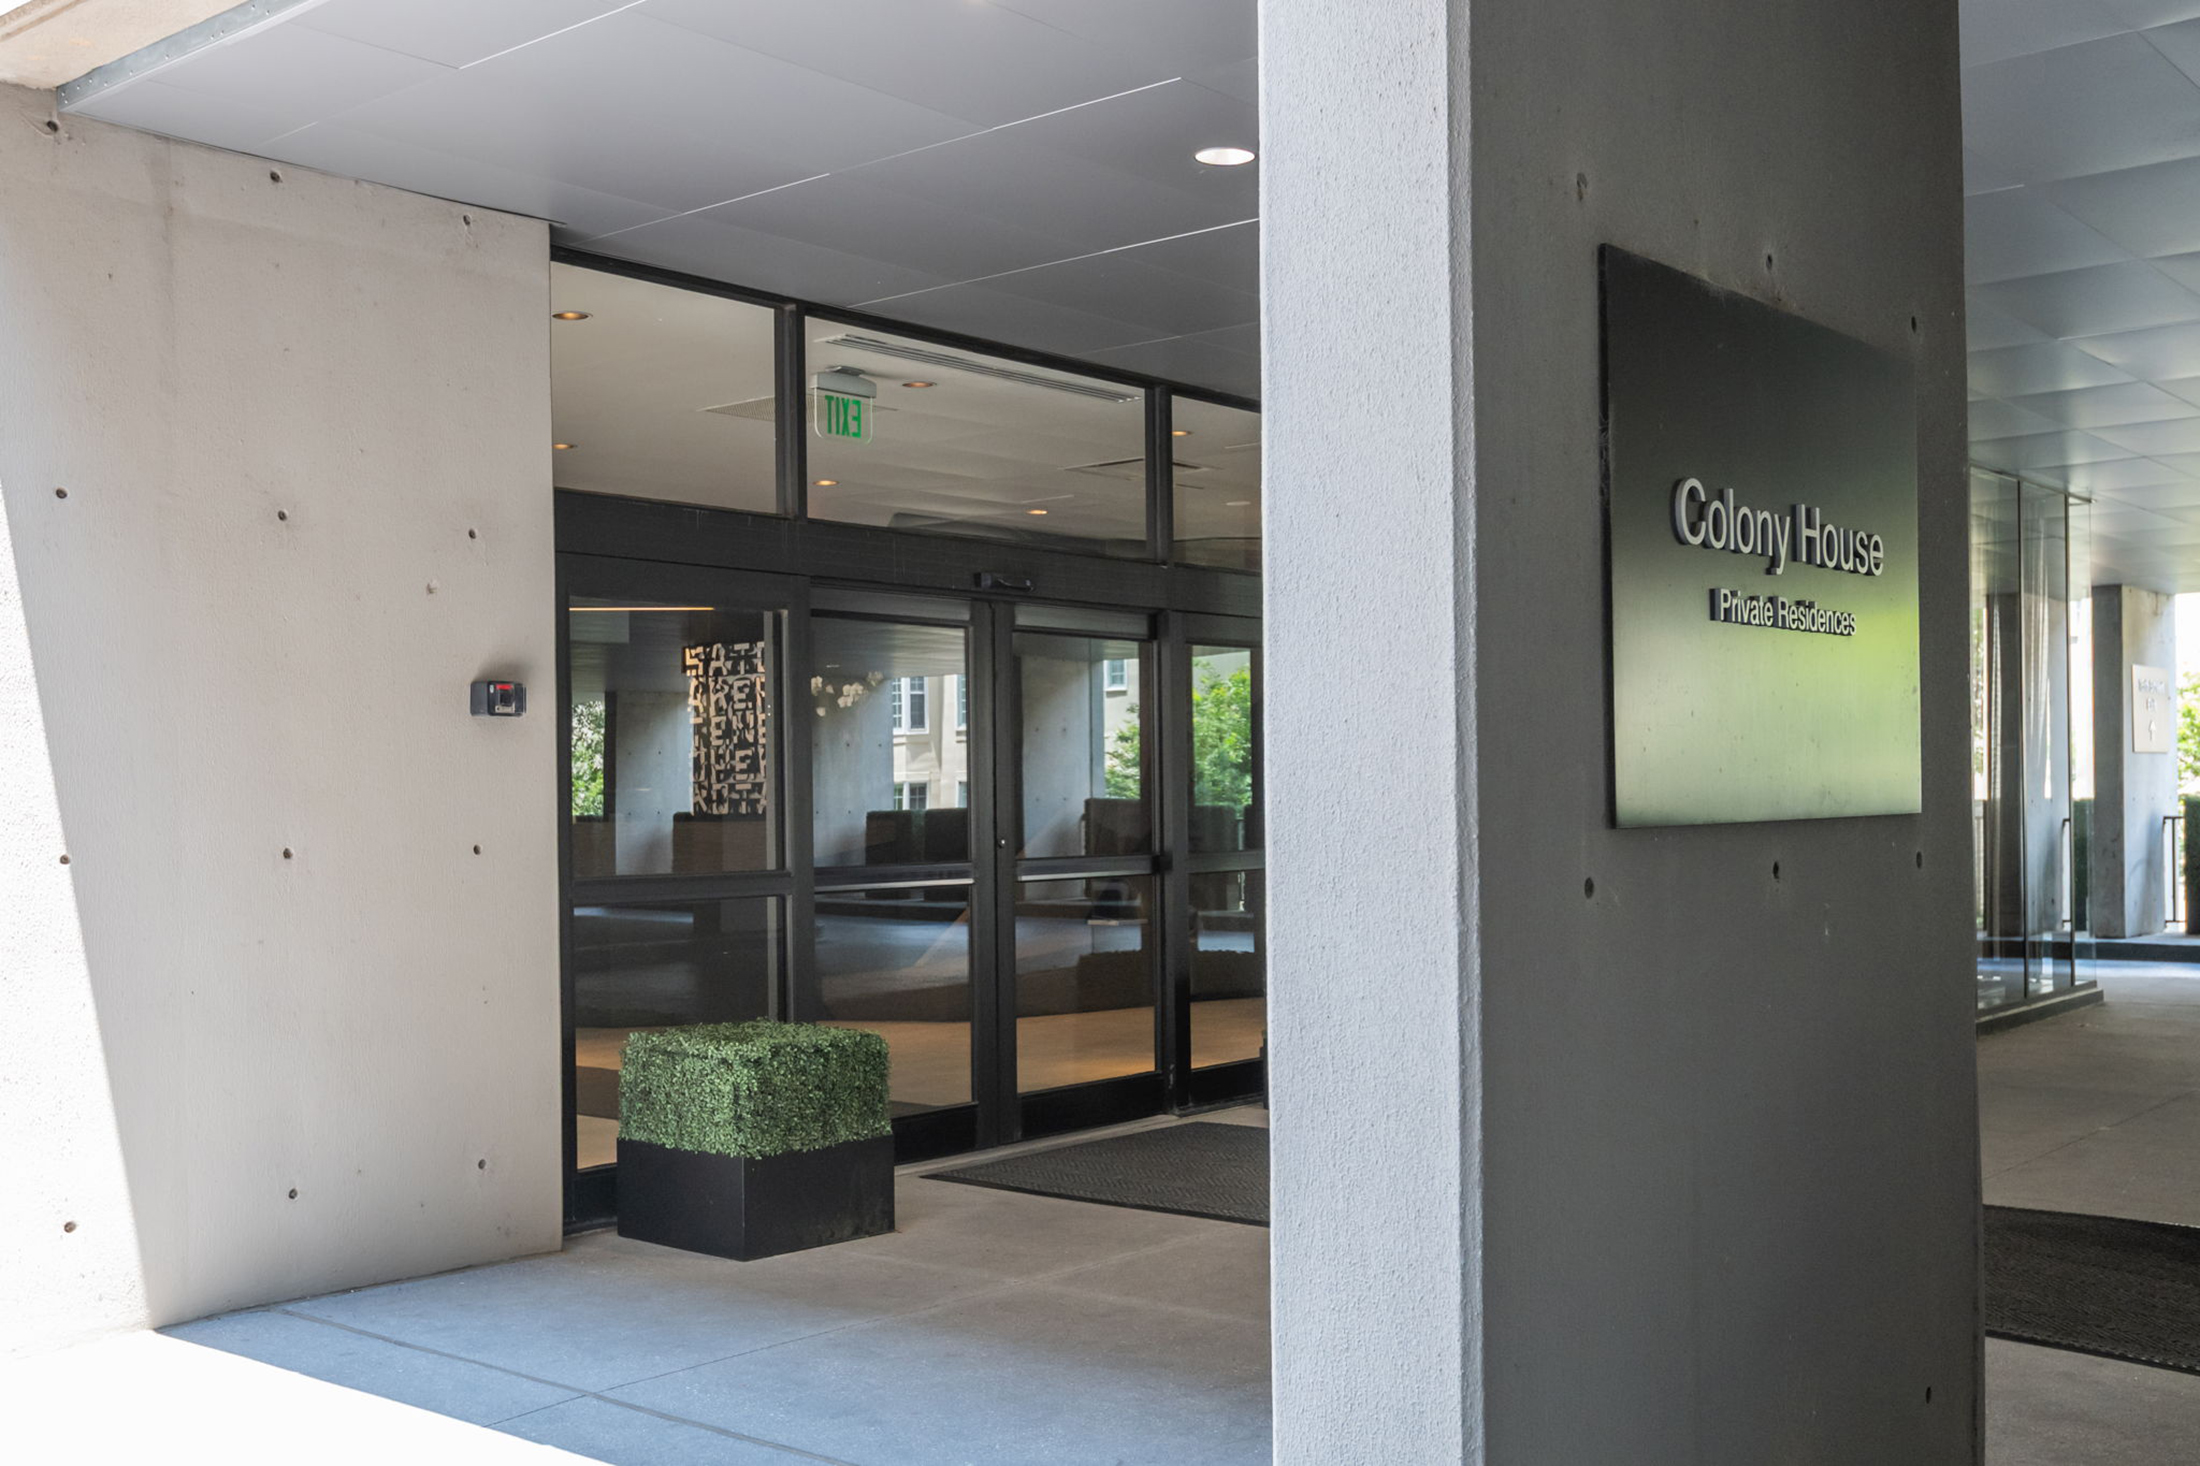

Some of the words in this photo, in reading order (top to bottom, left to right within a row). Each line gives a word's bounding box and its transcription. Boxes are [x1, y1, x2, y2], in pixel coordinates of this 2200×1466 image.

[1677, 477, 1790, 575] Colony
[1799, 503, 1884, 577] House
[1717, 587, 1774, 627] Private
[1776, 595, 1857, 636] Residences
